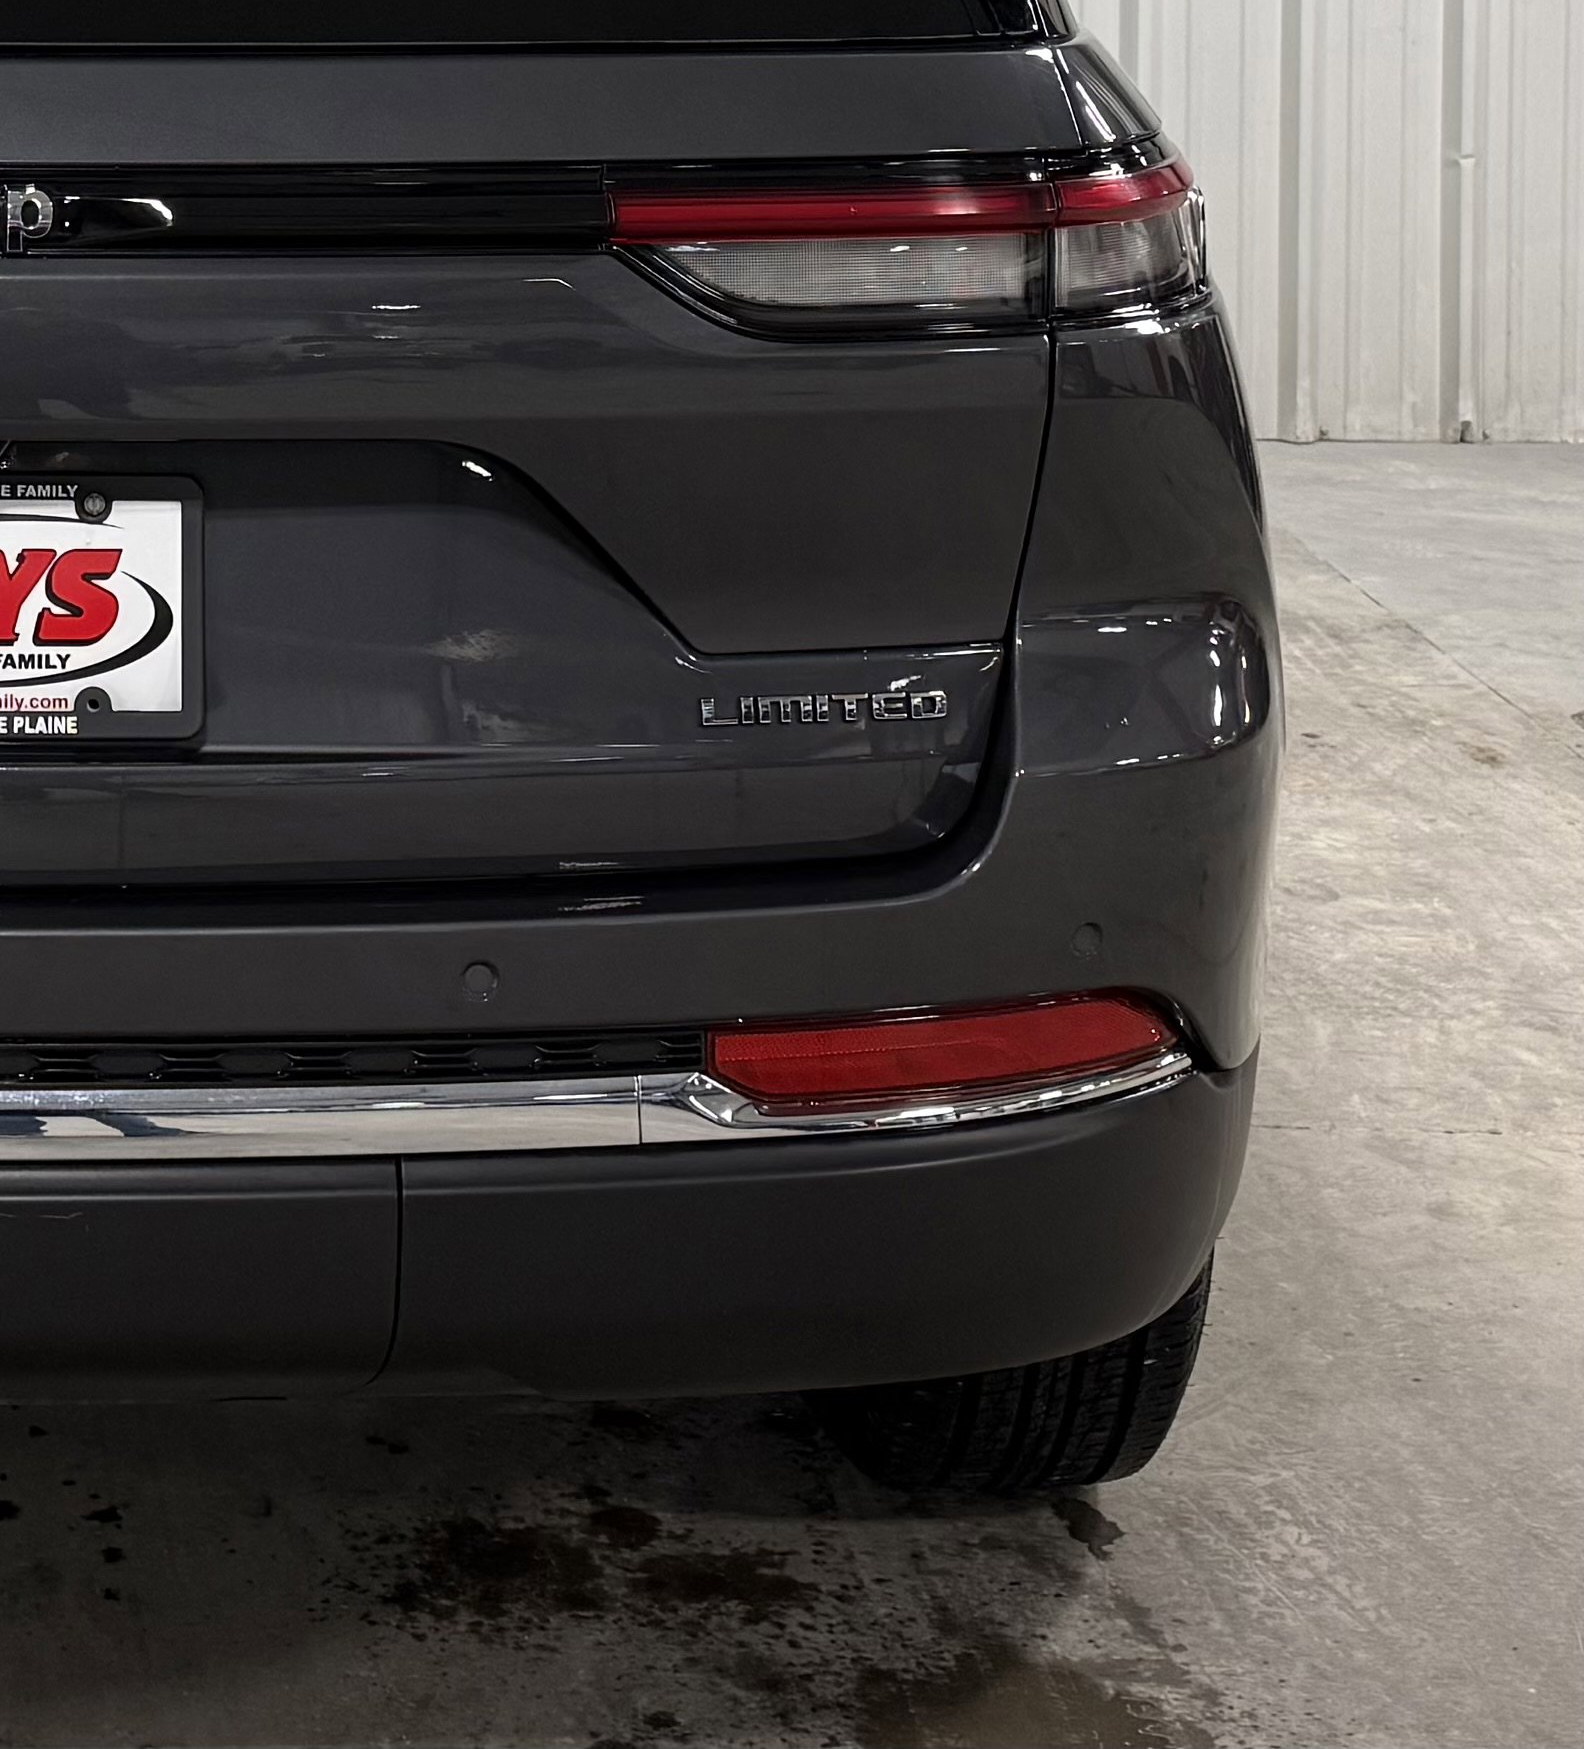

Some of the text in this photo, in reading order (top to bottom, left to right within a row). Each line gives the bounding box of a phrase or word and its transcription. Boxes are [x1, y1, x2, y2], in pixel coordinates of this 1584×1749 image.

[17, 484, 78, 498] FAMILY
[700, 690, 948, 725] LIMITED
[13, 716, 78, 734] PLAINE
